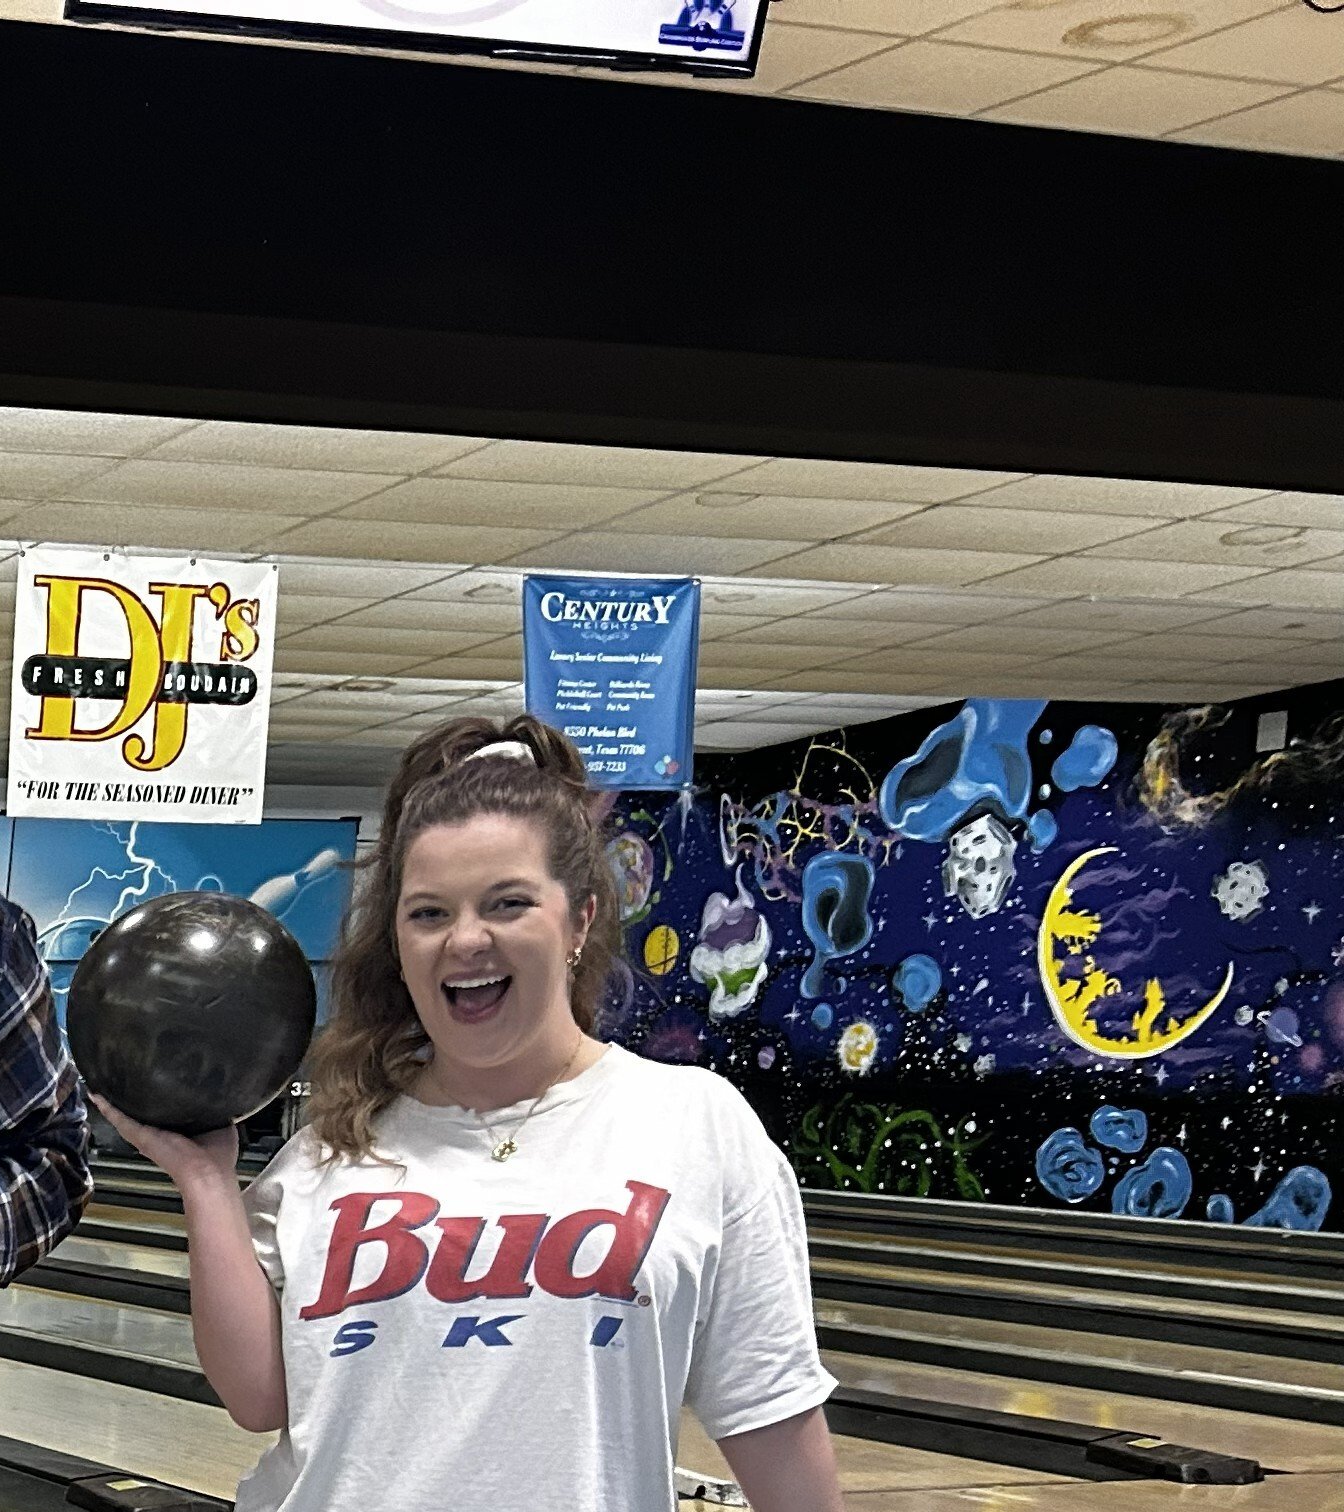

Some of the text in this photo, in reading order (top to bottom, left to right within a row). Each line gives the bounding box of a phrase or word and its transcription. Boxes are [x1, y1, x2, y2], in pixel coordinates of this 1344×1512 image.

[541, 591, 677, 624] CENTURY
[572, 622, 639, 631] HEIGHTS
[24, 574, 261, 772] DJ's
[32, 666, 251, 695] FRESH BOUDAIN
[64, 782, 101, 801] THE
[102, 783, 186, 804] SEASONED
[299, 1179, 672, 1321] Bud
